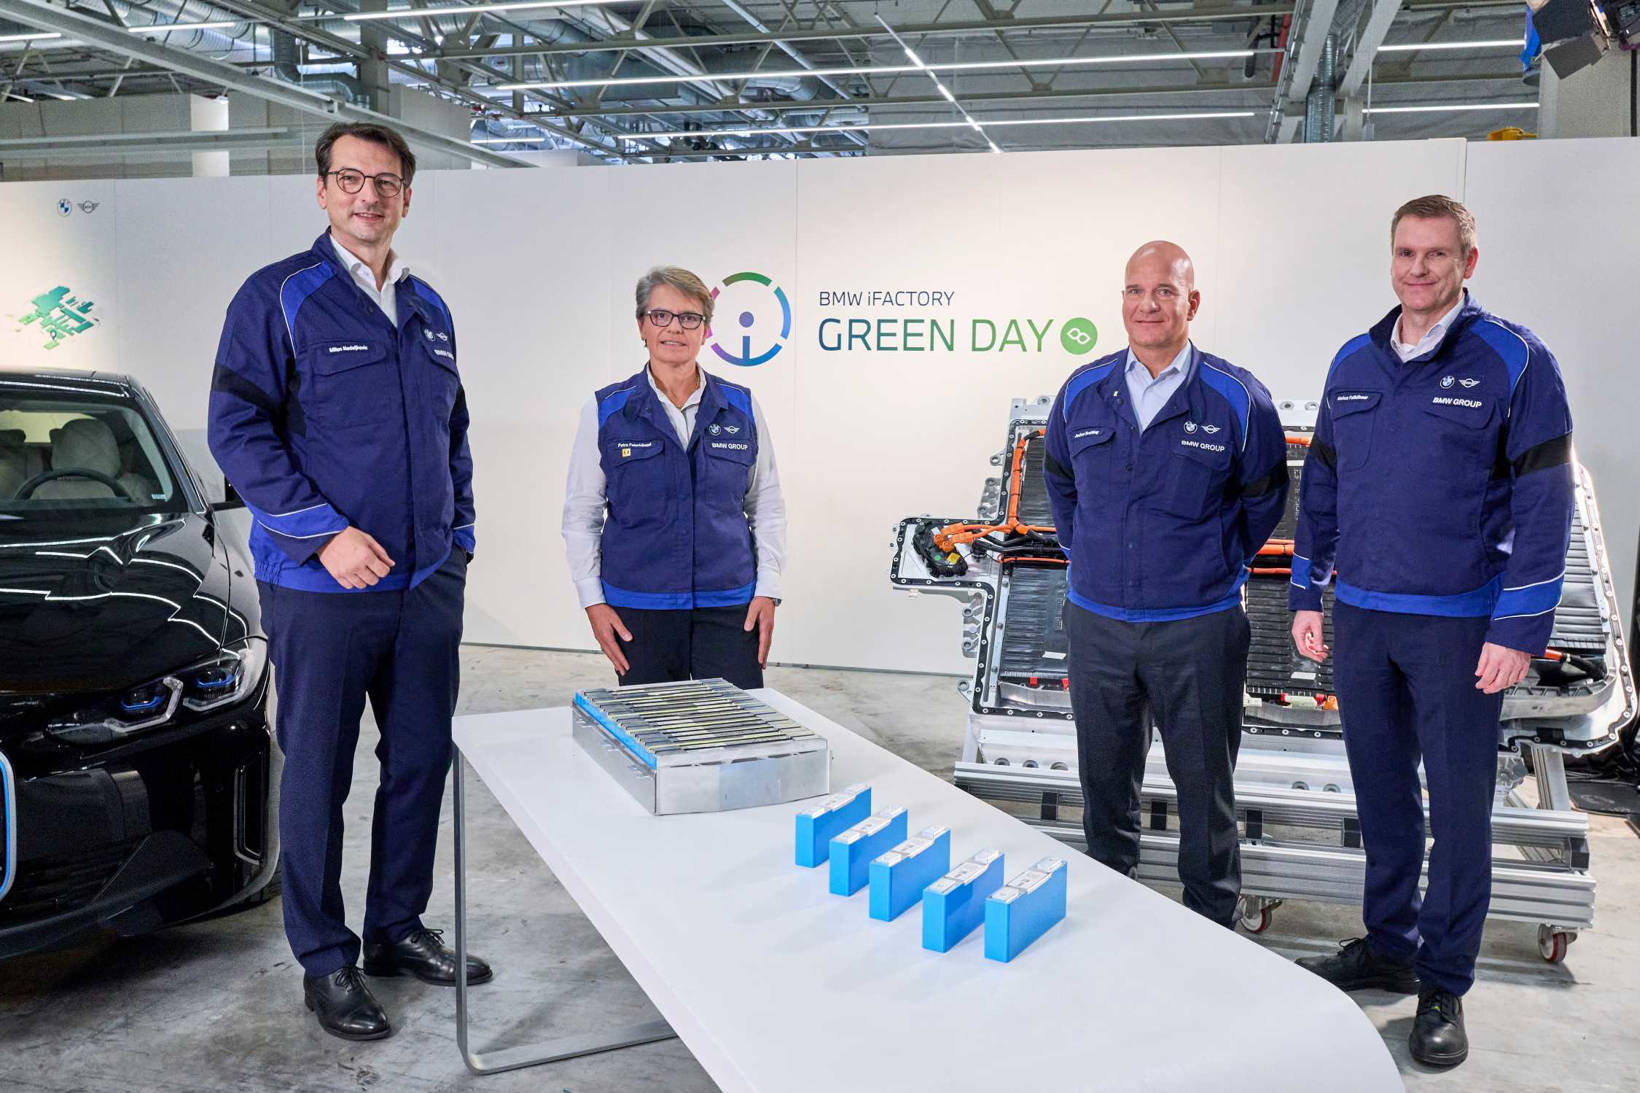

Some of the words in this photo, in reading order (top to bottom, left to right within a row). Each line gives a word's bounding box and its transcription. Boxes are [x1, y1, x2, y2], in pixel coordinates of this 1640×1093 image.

[819, 291, 863, 307] BMW
[867, 291, 955, 307] iFACTORY
[818, 318, 955, 352] GREEN
[971, 319, 1054, 353] DAY
[1432, 396, 1453, 405] BMW
[1453, 398, 1483, 409] GROUP
[711, 441, 728, 450] BMW
[728, 442, 749, 451] GROUP
[1181, 439, 1200, 449] BMW
[1200, 442, 1226, 453] GROUP
